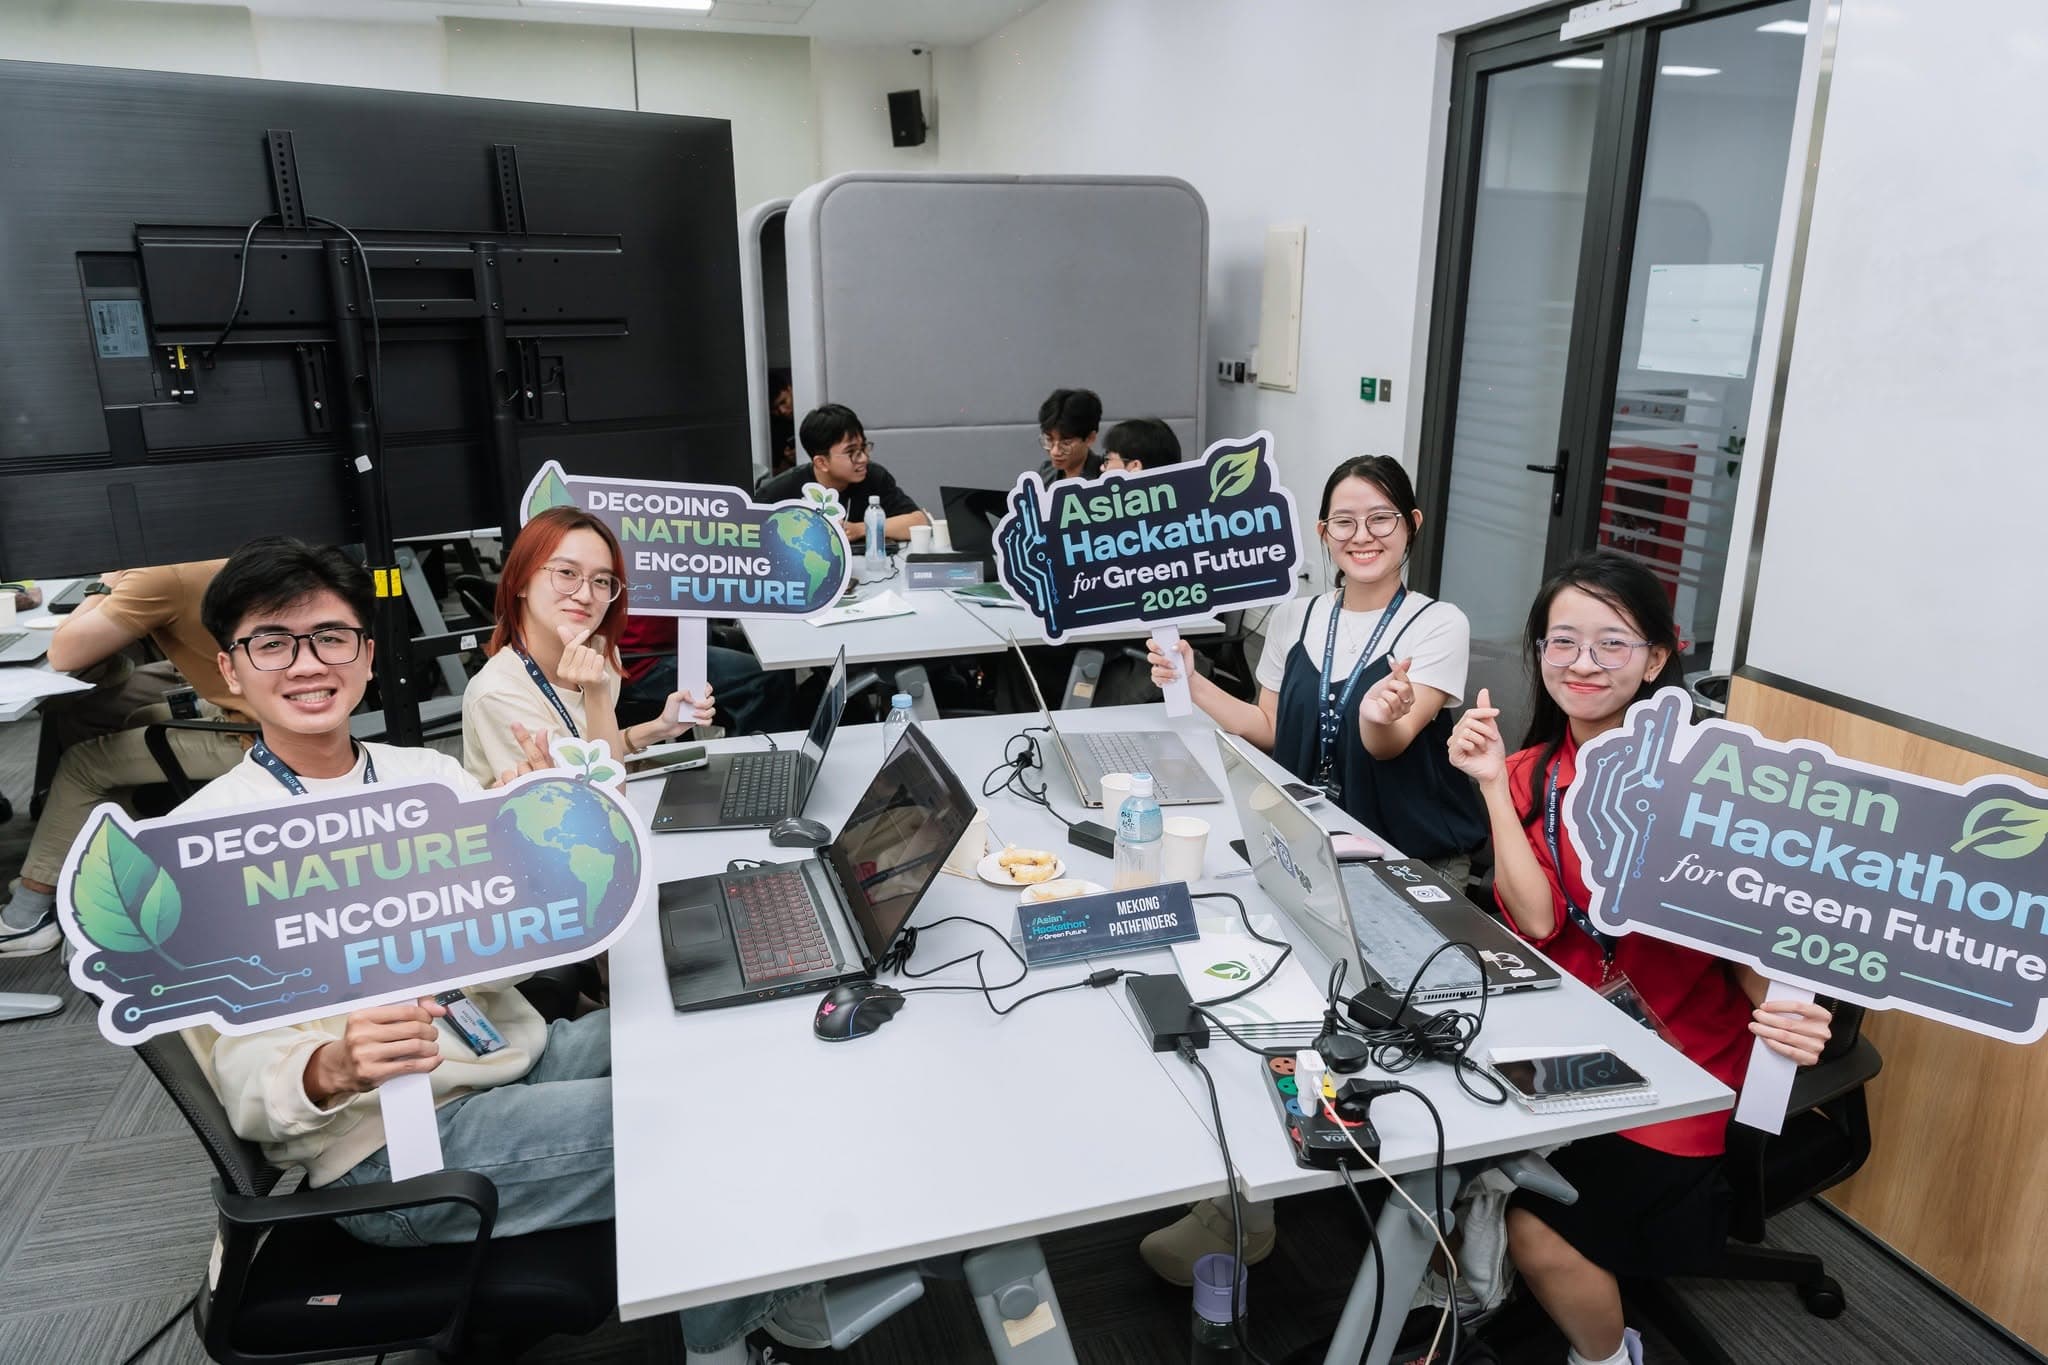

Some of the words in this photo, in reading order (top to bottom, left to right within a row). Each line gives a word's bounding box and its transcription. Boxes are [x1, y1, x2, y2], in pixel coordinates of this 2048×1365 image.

[588, 491, 729, 517] DECODING
[1059, 483, 1177, 529] Asian
[621, 517, 761, 548] NATURE
[1061, 504, 1282, 566] Hackathon
[635, 552, 771, 576] ENCODING
[1068, 571, 1102, 599] for
[1103, 559, 1189, 589] Green
[1193, 543, 1287, 575] Future
[670, 576, 806, 605] FUTURE
[1141, 583, 1208, 612] 2026
[1549, 791, 1557, 813] Future
[1692, 742, 1900, 834] Asian
[177, 799, 429, 869] DECODING
[1548, 813, 1556, 833] Green
[242, 824, 493, 906] NATURE
[1679, 791, 2048, 936] Hackathon
[274, 875, 516, 950] ENCODING
[1108, 912, 1179, 937] PATHFINDERS
[1116, 895, 1161, 916] MEKONG
[1659, 853, 1724, 886] for
[1726, 866, 1873, 934] Green
[1882, 907, 2048, 982] Future
[343, 897, 585, 985] FUTURE
[1032, 920, 1086, 935] Hackathon
[1065, 928, 1088, 937] Future
[1771, 926, 1889, 983] 2026
